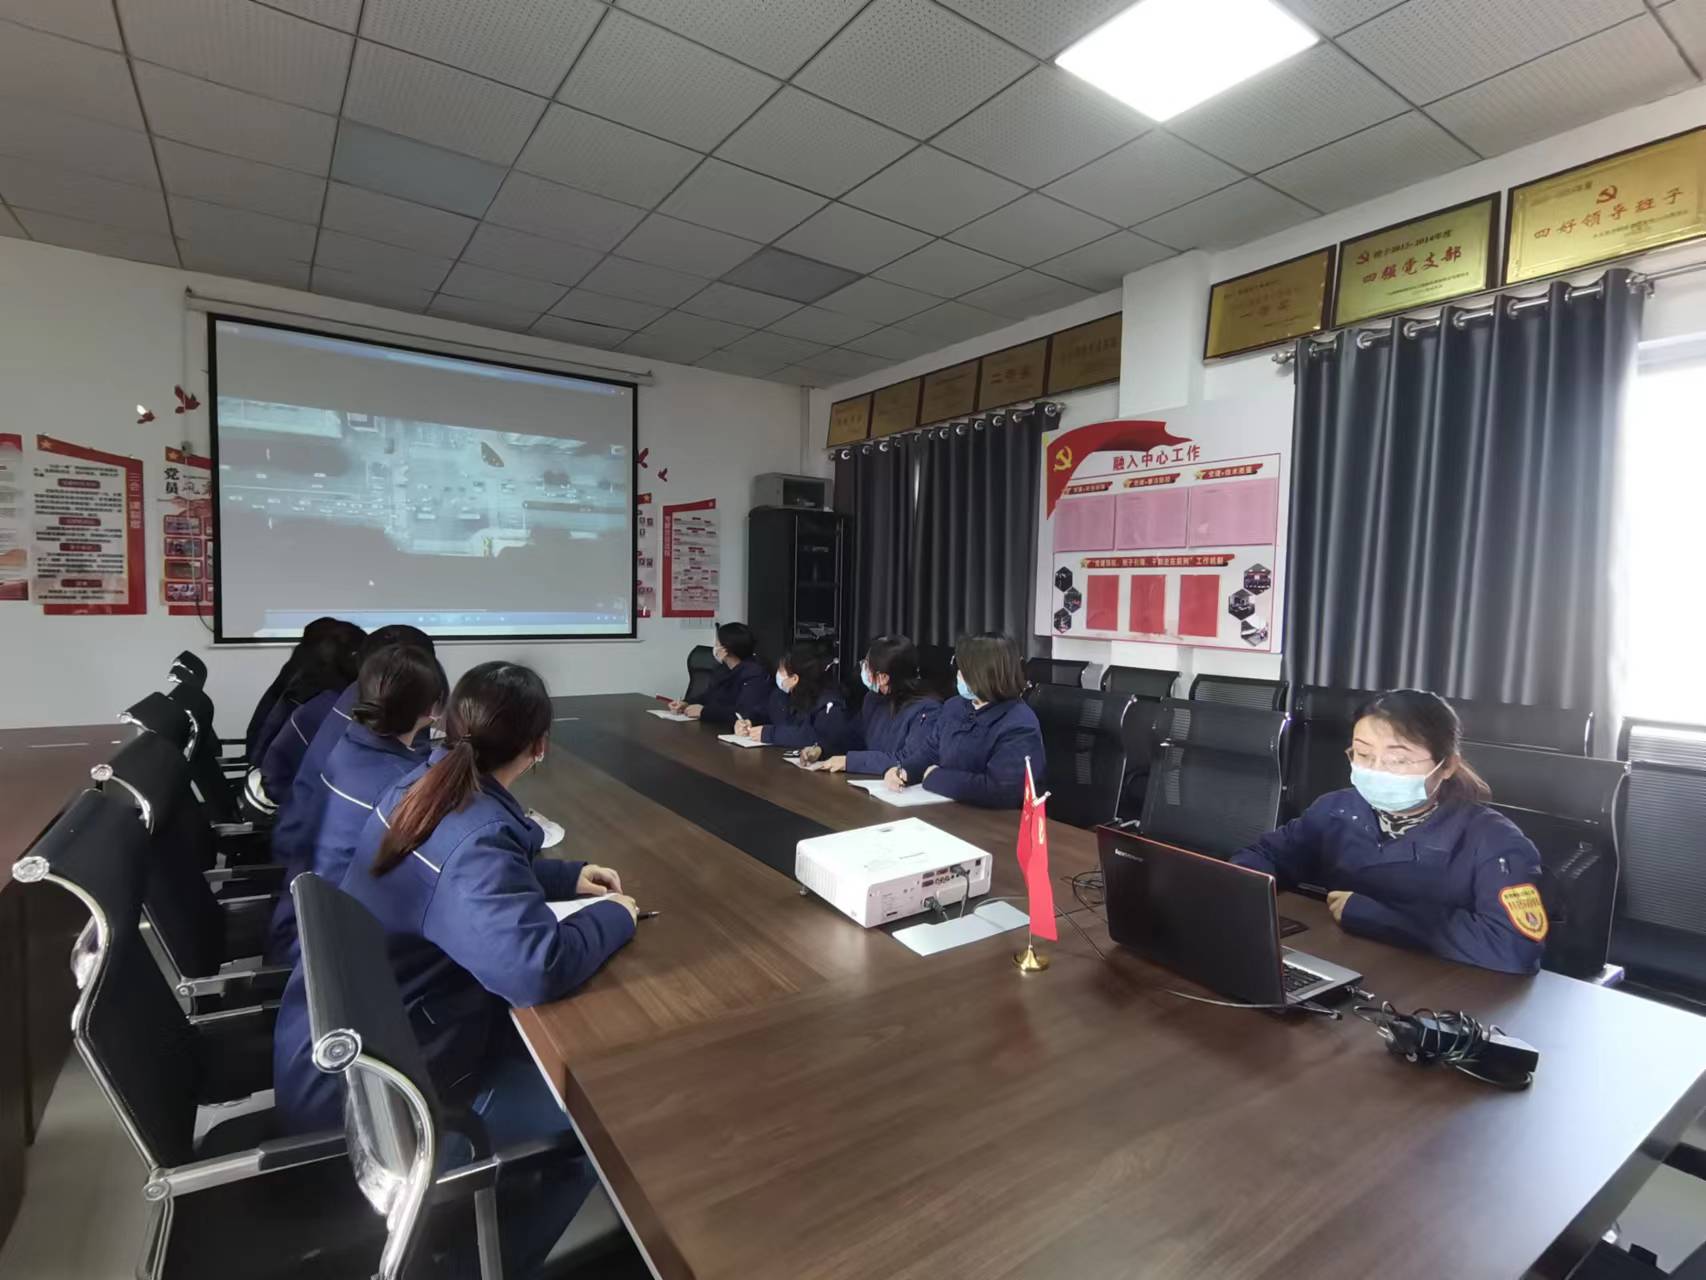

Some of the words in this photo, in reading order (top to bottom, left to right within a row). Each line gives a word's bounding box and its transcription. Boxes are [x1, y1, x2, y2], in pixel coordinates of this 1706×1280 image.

[1534, 186, 1684, 240] 四好领导班子
[1362, 245, 1462, 284] 四强党支部
[1113, 445, 1200, 471] 融入中心工作
[164, 467, 180, 495] 党员
